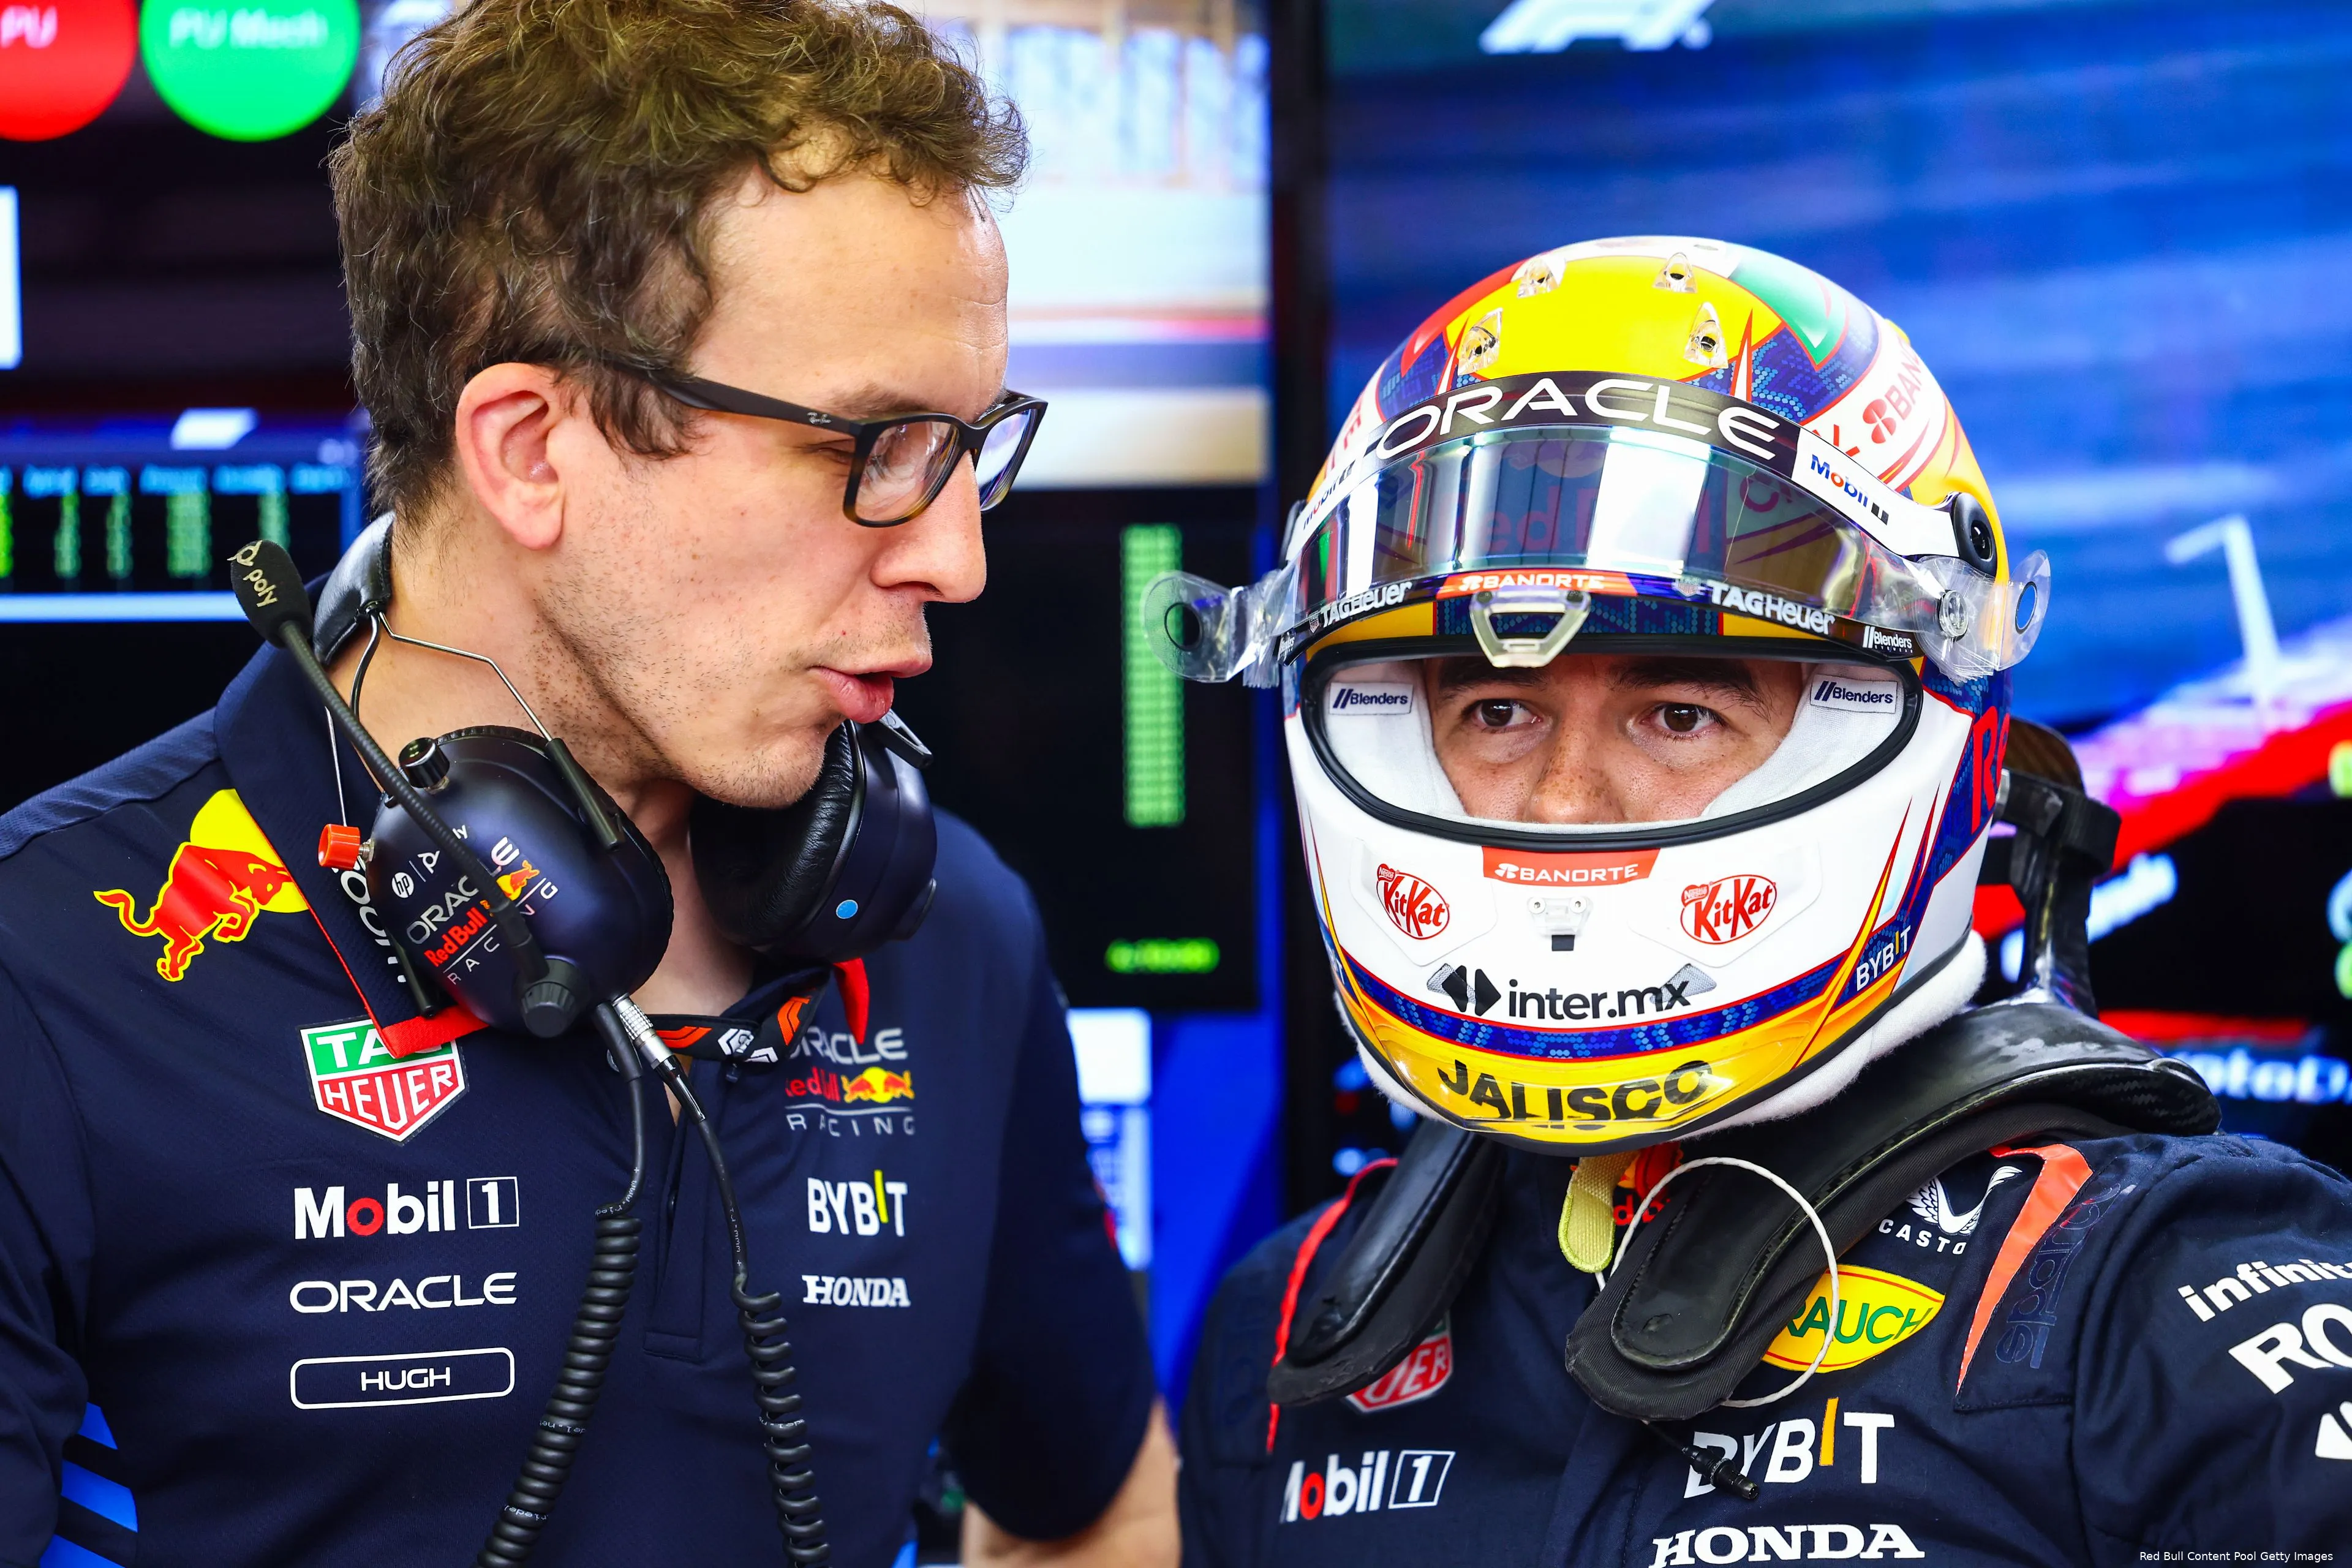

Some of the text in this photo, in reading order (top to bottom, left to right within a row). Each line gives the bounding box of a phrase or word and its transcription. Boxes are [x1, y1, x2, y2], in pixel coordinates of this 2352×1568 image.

[1376, 378, 1780, 461] ORACLE
[1811, 454, 1868, 507] Mobil
[243, 569, 278, 608] poly
[1483, 574, 1605, 590] BANORTE
[1874, 631, 1912, 649] Blenders
[1350, 693, 1408, 706] Blenders
[1832, 687, 1893, 704] Blenders
[1520, 864, 1639, 883] BANORTE
[1855, 925, 1912, 991] BYBIT
[1508, 978, 1692, 1020] inter.mx
[316, 1028, 443, 1068] TA
[323, 1066, 453, 1130] HEUER
[1437, 1059, 1713, 1129] JALISCO
[294, 1180, 456, 1240] Mobil
[807, 1169, 908, 1237] BYBIT
[290, 1272, 517, 1313] ORACLE
[802, 1275, 911, 1308] HONDA
[361, 1367, 450, 1391] HUGH
[1363, 1346, 1447, 1403] UER
[1648, 1523, 1925, 1568] HONDA
